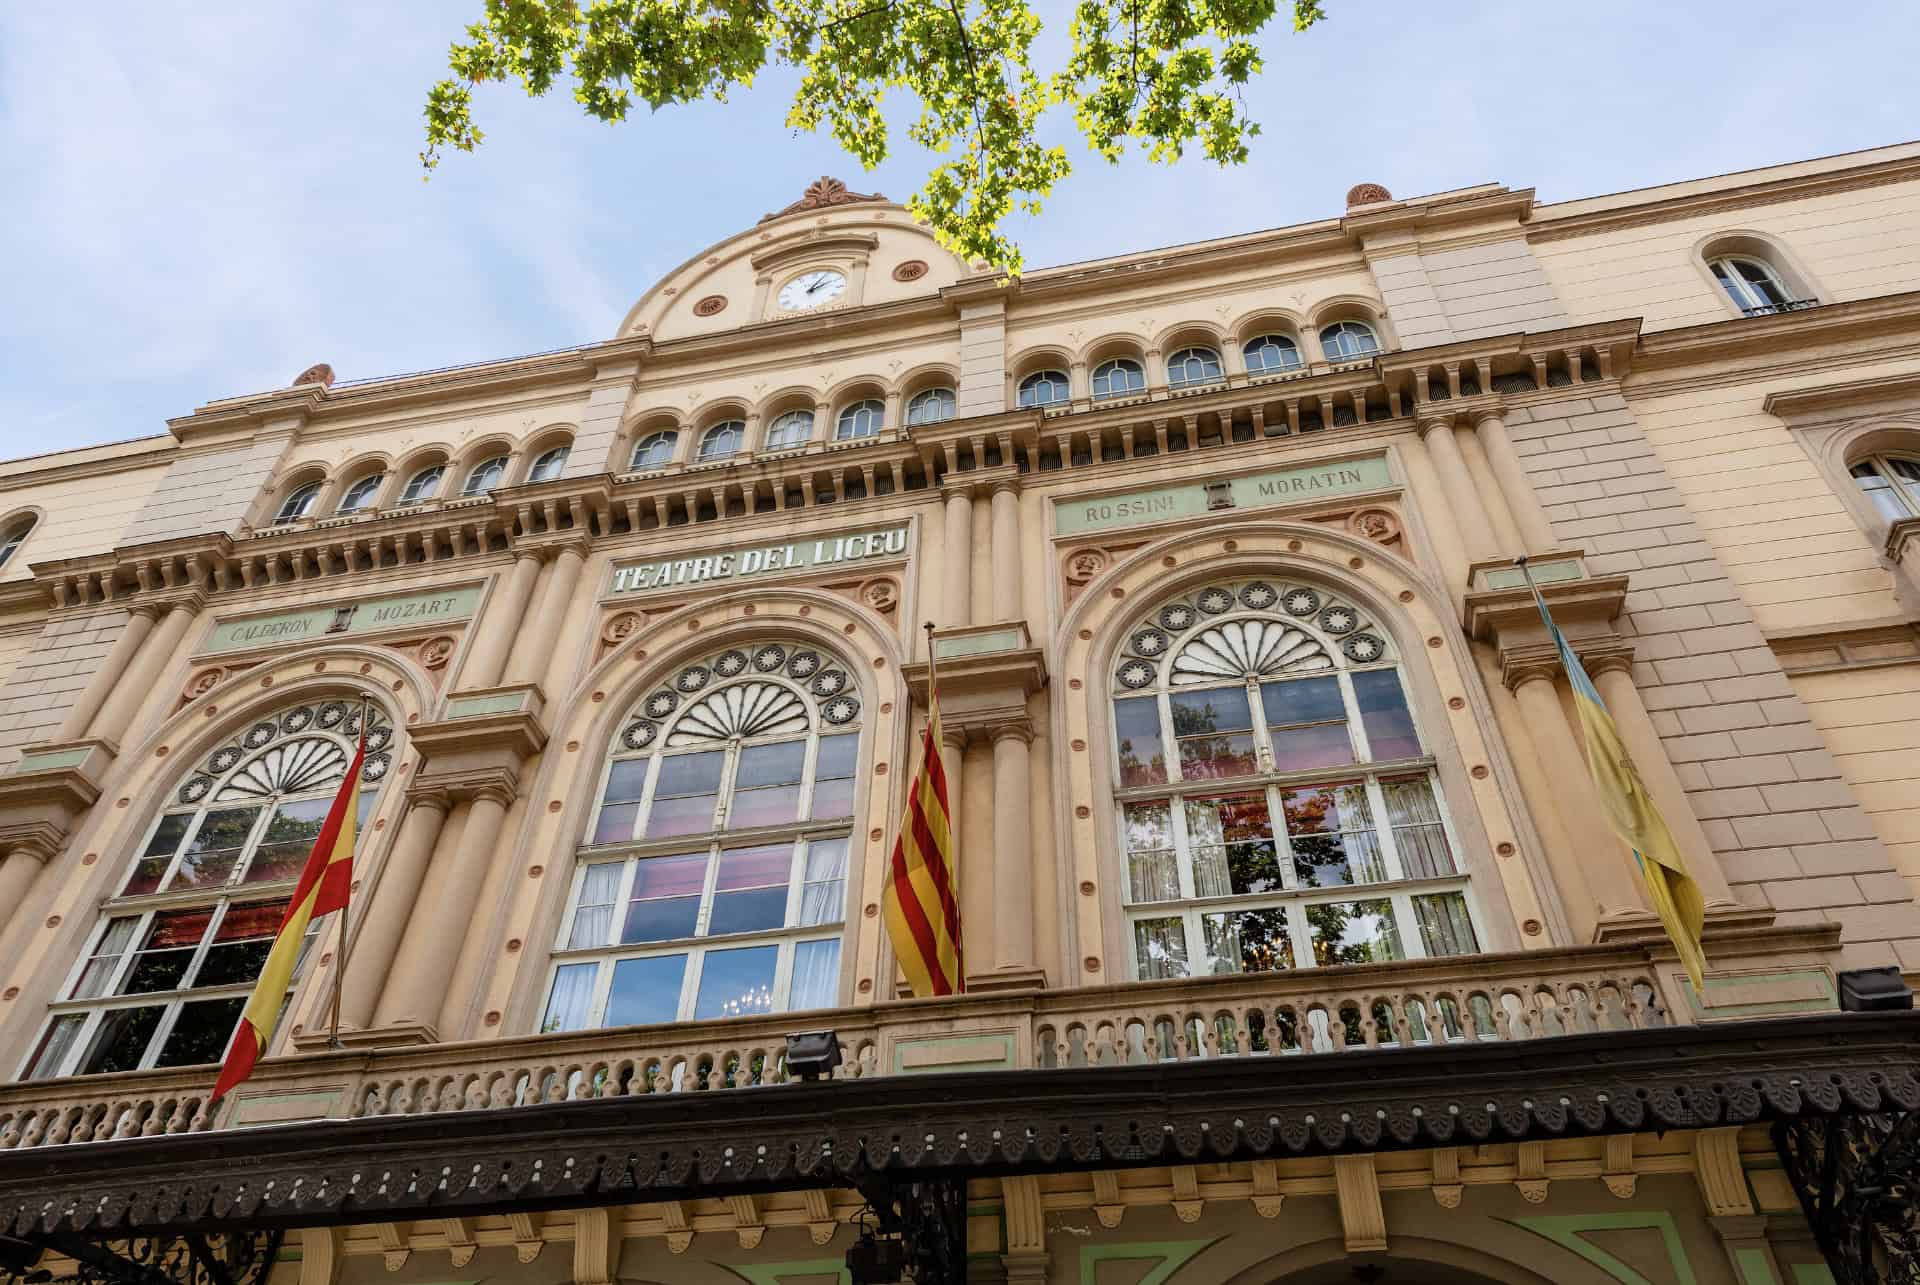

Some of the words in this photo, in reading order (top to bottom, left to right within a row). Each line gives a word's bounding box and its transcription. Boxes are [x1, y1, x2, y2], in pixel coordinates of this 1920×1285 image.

[1085, 495, 1174, 521] ROSSINI
[1258, 469, 1361, 497] MORATIN
[614, 554, 736, 593] TEATRE
[738, 545, 804, 576] DEL
[812, 527, 908, 566] LICEU
[374, 598, 457, 622] MOZART
